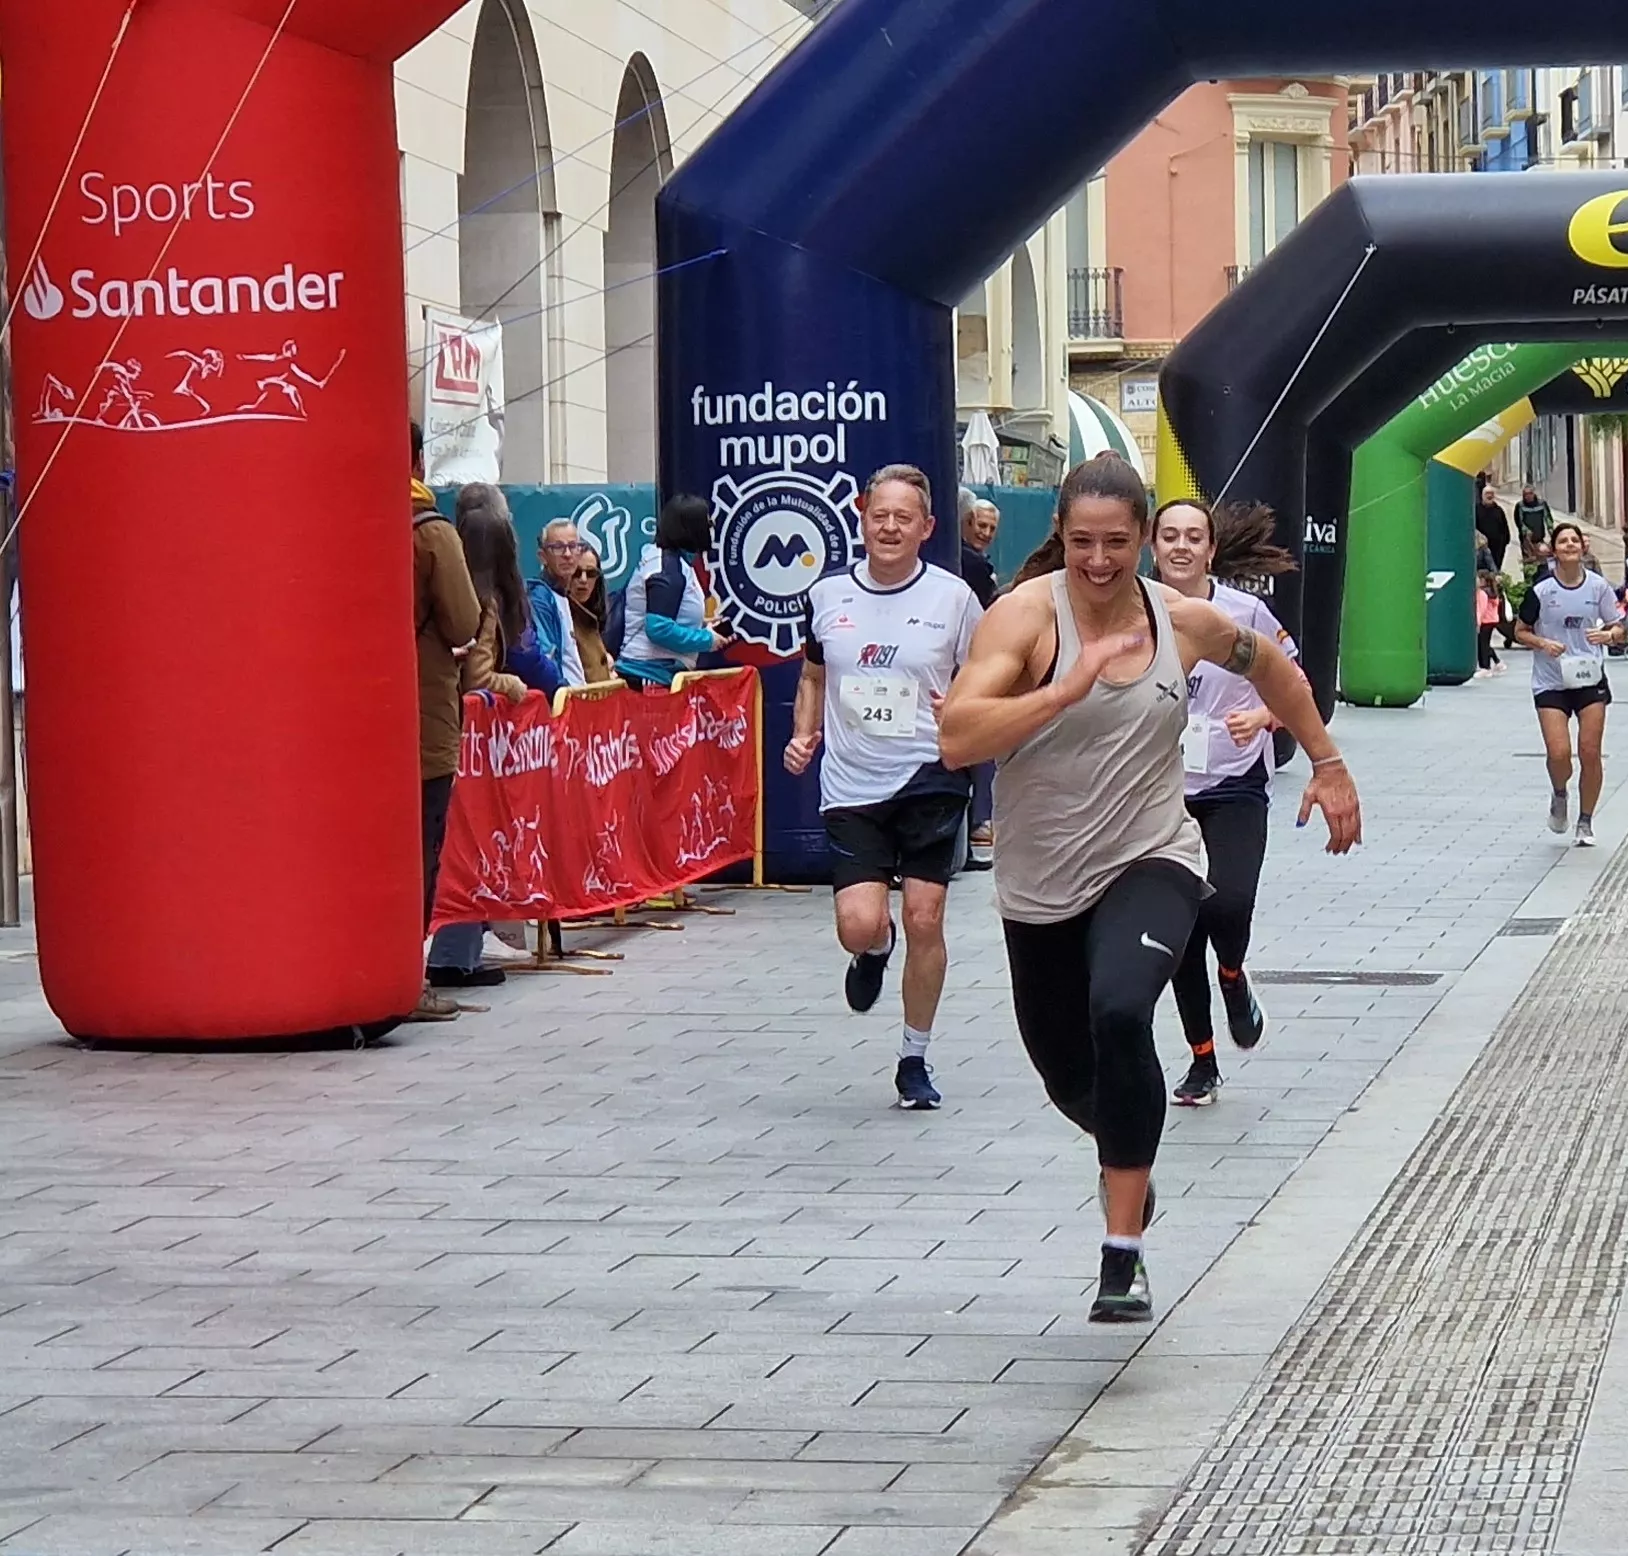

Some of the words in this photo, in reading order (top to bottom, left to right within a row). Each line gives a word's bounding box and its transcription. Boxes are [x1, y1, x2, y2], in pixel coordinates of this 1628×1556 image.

[80, 171, 255, 237] Sports
[70, 263, 345, 319] Santander
[691, 381, 887, 426] fundación
[720, 423, 846, 471] mupol
[753, 500, 765, 513] de
[766, 496, 778, 508] la
[781, 494, 836, 533] Mutualidad
[729, 511, 753, 566] Fundación
[829, 534, 840, 548] de
[1303, 514, 1338, 543] iva
[830, 550, 841, 562] la
[862, 707, 893, 722] 243
